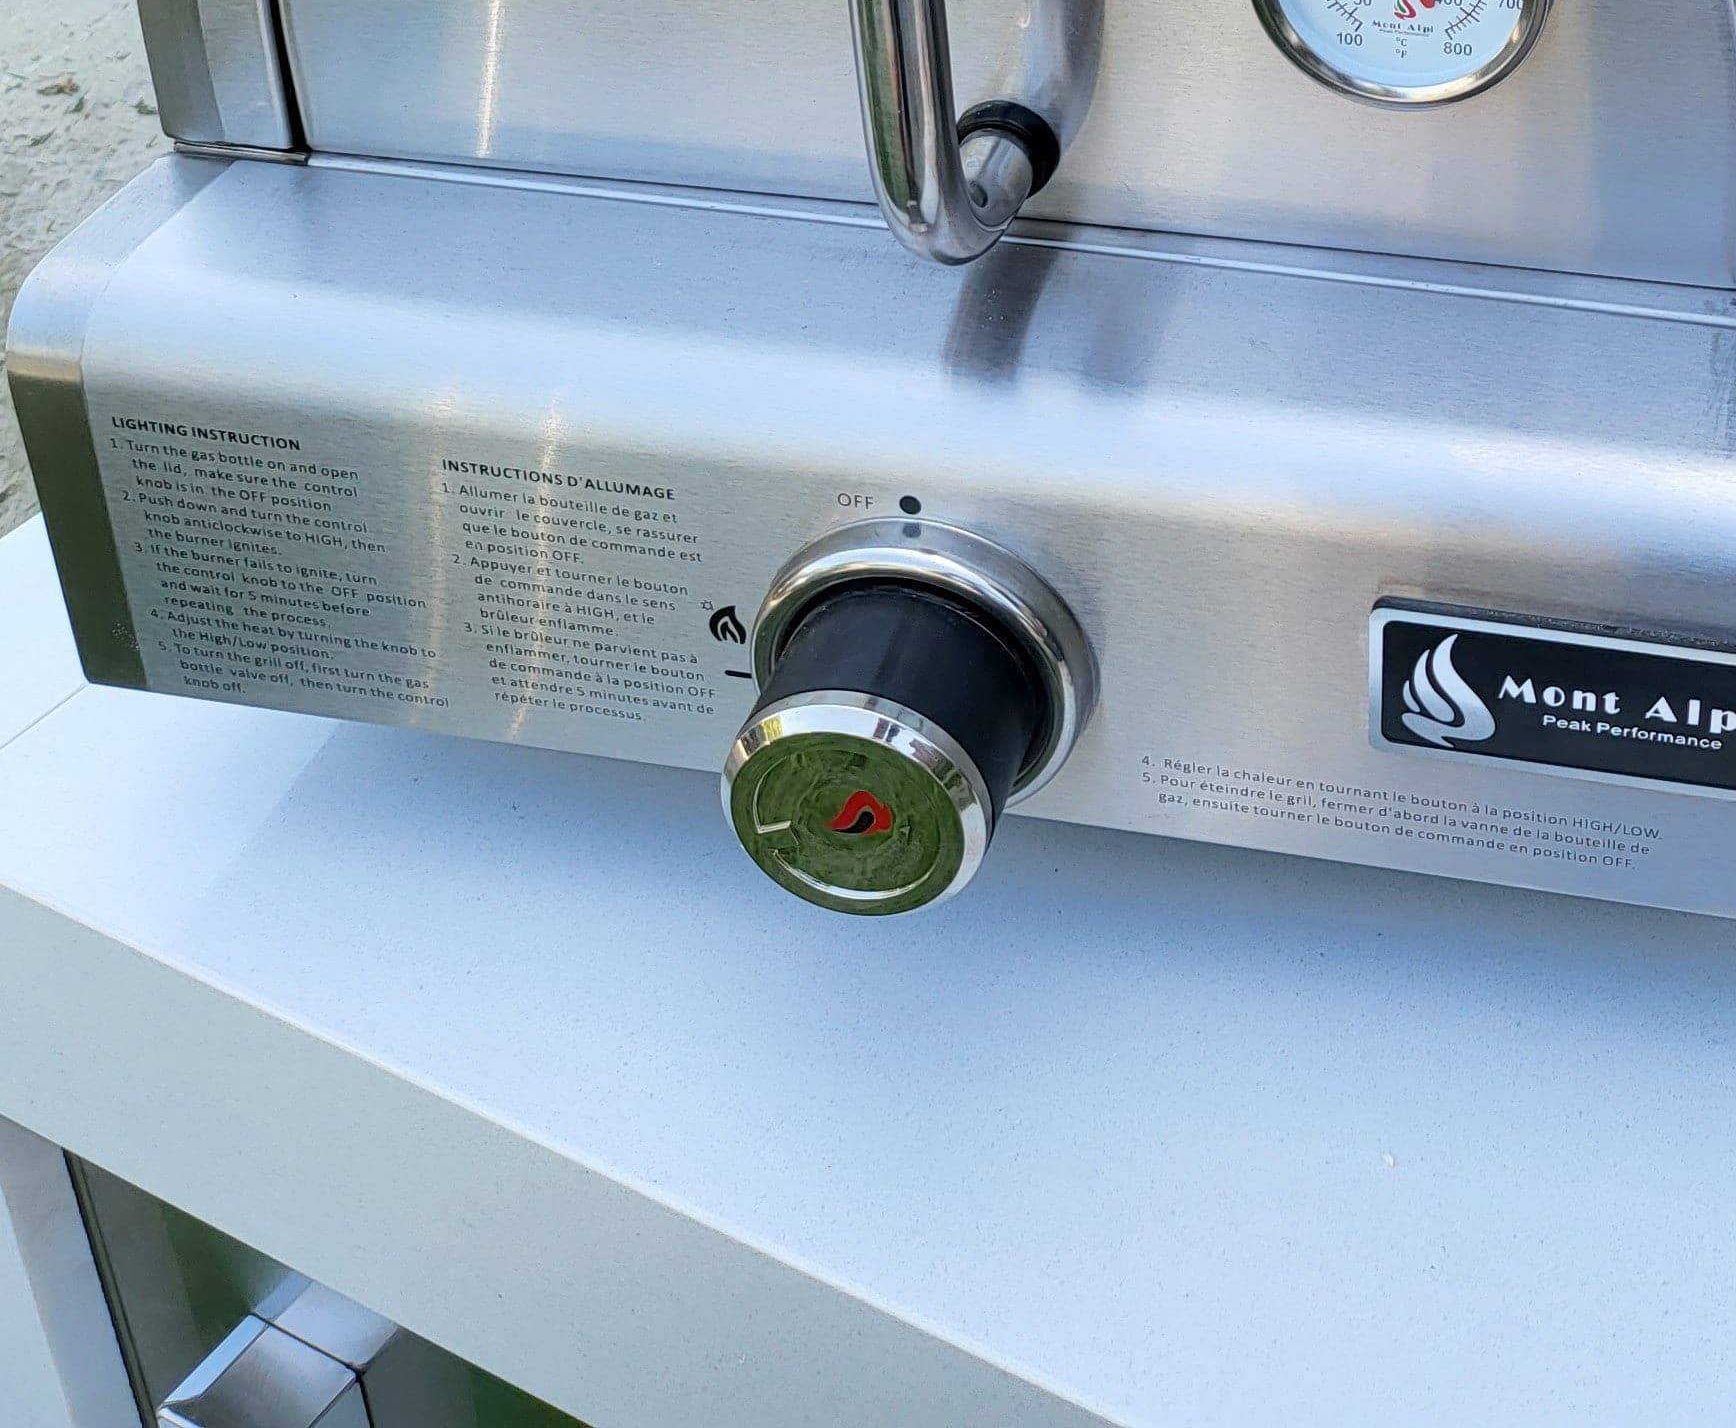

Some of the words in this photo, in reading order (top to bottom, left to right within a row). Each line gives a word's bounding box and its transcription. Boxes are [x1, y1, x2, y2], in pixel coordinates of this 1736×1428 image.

[1336, 32, 1363, 46] 100
[1372, 19, 1401, 30] Mont
[1443, 41, 1473, 56] 800
[111, 416, 187, 436] LIGHTING
[191, 426, 300, 450] INSTRUCTION
[124, 439, 159, 454] Turn
[162, 444, 187, 457] the
[191, 450, 215, 462] gas
[217, 450, 263, 468] bottle
[266, 460, 285, 471] on
[288, 463, 316, 474] and
[320, 467, 358, 480] open
[131, 458, 156, 470] the
[194, 467, 233, 481] make
[236, 473, 268, 485] sure
[271, 476, 296, 489] the
[304, 482, 357, 497] control
[442, 458, 562, 485] INSTRUCTIONS
[566, 475, 674, 500] D'ALLUMAGE
[135, 474, 172, 490] knob
[175, 480, 187, 492] is
[189, 482, 204, 494] in
[210, 485, 236, 498] the
[238, 489, 266, 502] OFF
[270, 495, 331, 511] position
[459, 484, 517, 502] Allumer
[522, 491, 535, 504] la
[539, 494, 607, 514] bouteille
[611, 504, 629, 517] de
[634, 509, 658, 521] gaz
[662, 513, 677, 523] et
[837, 492, 873, 510] OFF
[138, 492, 173, 507] Push
[176, 497, 217, 512] down
[220, 506, 247, 517] and
[250, 508, 282, 522] turn
[285, 512, 310, 525] the
[314, 518, 367, 533] control
[143, 509, 180, 524] knob
[183, 517, 282, 538] anticlockwise
[283, 530, 301, 540] to
[351, 537, 385, 552] then
[459, 504, 505, 518] ouvrir
[516, 509, 529, 521] le
[615, 525, 631, 535] se
[636, 528, 697, 543] rassurer
[146, 527, 172, 540] the
[174, 529, 224, 548] burner
[462, 522, 490, 534] que
[493, 523, 507, 536] le
[510, 526, 565, 544] bouton
[569, 534, 587, 546] de
[591, 539, 675, 558] commande
[679, 551, 701, 562] est
[464, 540, 483, 550] en
[486, 543, 548, 559] position
[470, 556, 532, 574] Appuyer
[536, 566, 551, 576] et
[554, 568, 612, 585] tourner
[616, 574, 629, 587] le
[633, 577, 688, 595] bouton
[474, 573, 492, 585] de
[499, 579, 582, 597] commande
[586, 588, 621, 604] dans
[625, 593, 638, 605] le
[642, 598, 675, 610] sens
[477, 592, 560, 612] antihoraire
[563, 601, 572, 613] à
[623, 612, 638, 622] et
[641, 612, 654, 624] le
[479, 606, 537, 624] brûleur
[1498, 675, 1621, 715] Mont
[1542, 714, 1592, 733] Peak
[1596, 721, 1722, 750] Performance
[1164, 758, 1212, 774] Régler
[1216, 764, 1229, 777] la
[1233, 769, 1292, 786] chaleur
[1295, 779, 1314, 790] en
[1319, 782, 1388, 801] tournant
[1392, 790, 1406, 803] le
[1410, 793, 1467, 812] bouton
[1471, 802, 1479, 813] à
[1485, 804, 1497, 816] la
[1502, 809, 1567, 826] position
[1160, 774, 1196, 789] Pour
[1199, 779, 1265, 799] éteindre
[1269, 789, 1283, 801] le
[1321, 797, 1374, 814] fermer
[1378, 805, 1438, 824] d'abord
[1443, 814, 1456, 827] la
[1460, 819, 1508, 834] vanne
[1512, 825, 1531, 837] de
[1536, 827, 1549, 840] la
[1554, 830, 1625, 851] bouteille
[1630, 842, 1649, 854] de
[1192, 798, 1249, 813] ensuite
[1252, 805, 1312, 822] tourner
[1316, 812, 1329, 825] le
[1334, 815, 1389, 834] bouton
[1394, 825, 1413, 837] de
[1417, 830, 1504, 850] commande
[1509, 843, 1527, 854] en
[1532, 847, 1597, 863] position
